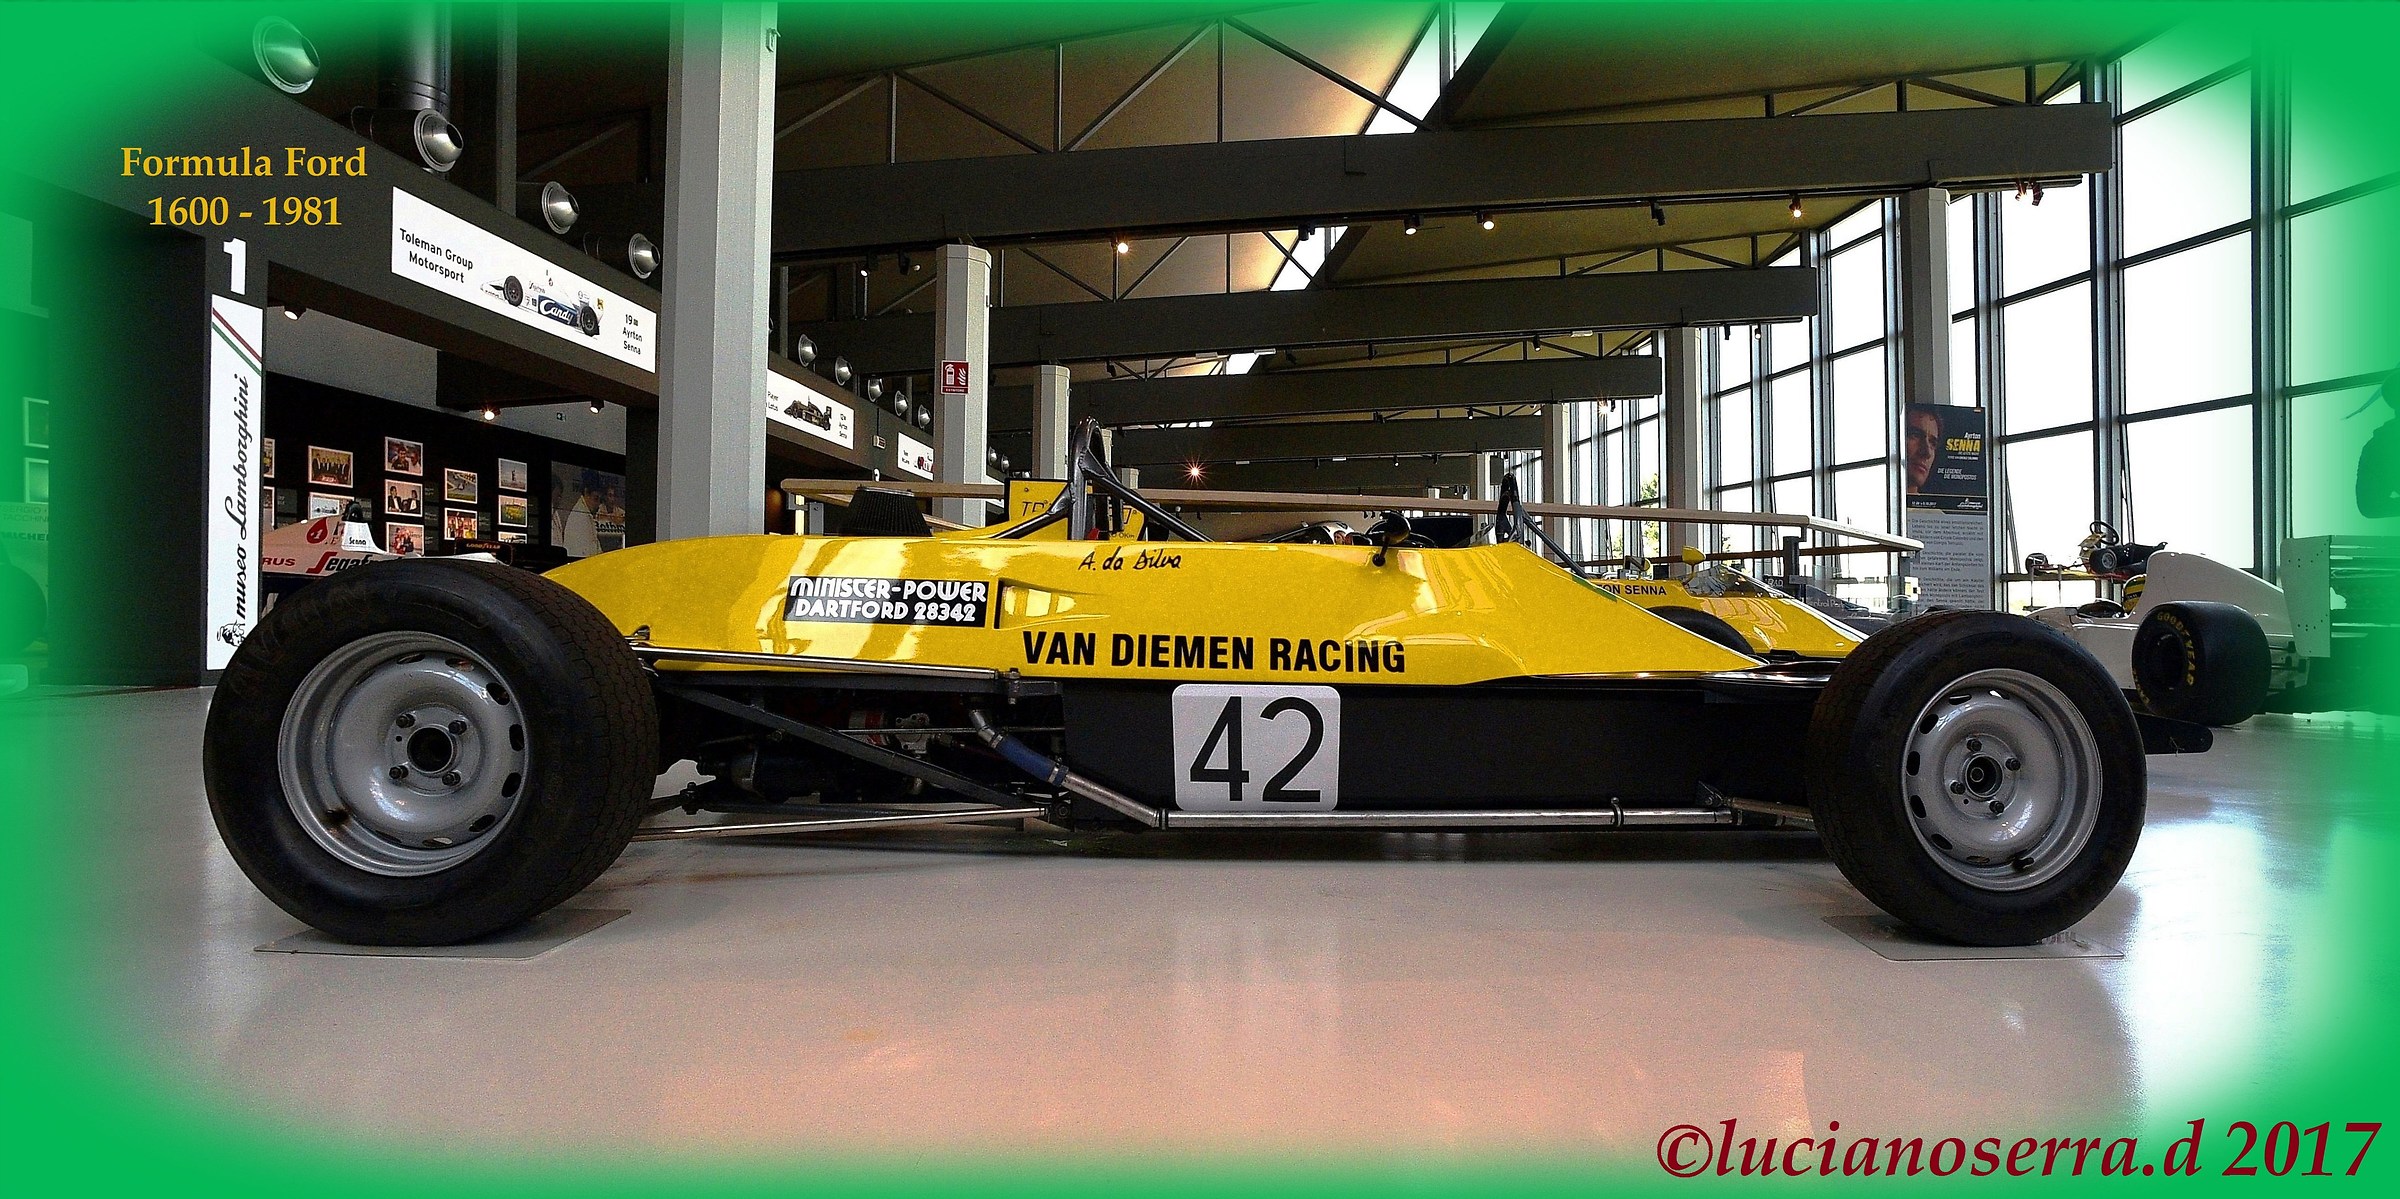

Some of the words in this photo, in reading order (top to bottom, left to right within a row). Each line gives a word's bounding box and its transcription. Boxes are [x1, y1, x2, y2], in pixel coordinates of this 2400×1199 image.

[399, 227, 443, 257] Toleman
[445, 248, 475, 271] Group
[223, 237, 247, 296] 1
[408, 250, 465, 284] Motorsport
[540, 300, 576, 325] Candy
[622, 327, 643, 342] Ayrton
[623, 340, 642, 355] Senna
[1945, 438, 1981, 453] SENNA
[1963, 431, 1981, 440] Ayrton
[224, 373, 254, 541] Lamborghini
[1101, 545, 1125, 572] da
[1132, 549, 1182, 571] Silva
[232, 543, 248, 622] museo
[790, 576, 987, 603] MINISTER-POWER
[1624, 584, 1667, 596] SENNA
[795, 599, 909, 622] DARTFORD
[914, 602, 977, 623] 28342
[1022, 630, 1097, 666] VAN
[1111, 633, 1254, 670] DIEMEN
[1269, 638, 1406, 674] RACING
[2156, 611, 2196, 686] GOODYEAR
[1189, 695, 1325, 803] 42
